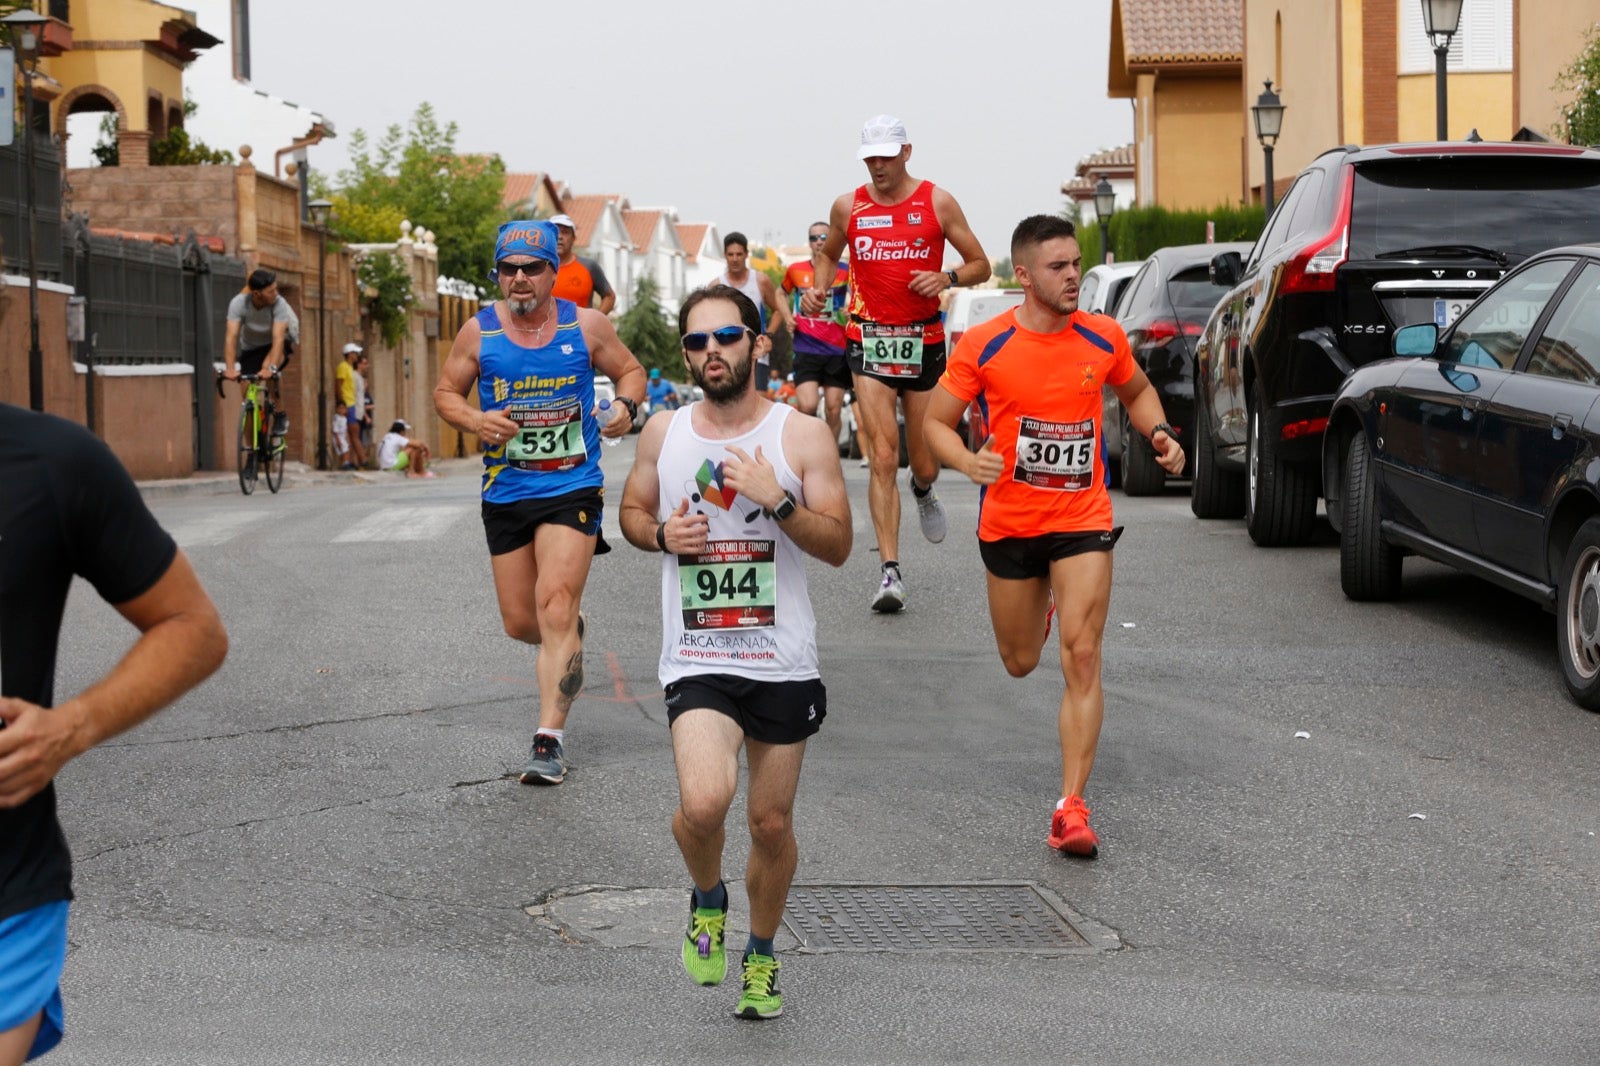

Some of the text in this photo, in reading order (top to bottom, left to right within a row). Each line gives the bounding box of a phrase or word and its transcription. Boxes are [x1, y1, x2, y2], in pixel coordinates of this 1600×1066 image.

[855, 236, 930, 261] Polisalud
[875, 340, 914, 360] 618
[512, 390, 553, 399] deportes
[524, 411, 539, 421] GRAN
[539, 410, 559, 420] PREMIO
[1040, 422, 1055, 433] GRAN
[1055, 424, 1074, 433] PREMIO
[522, 426, 570, 455] 531
[1026, 442, 1091, 466] 3015
[715, 541, 739, 553] PREMIO
[739, 541, 747, 552] DE
[748, 541, 769, 552] FONDO
[696, 567, 760, 602] 944
[680, 648, 775, 660] apoyamoseldeporte
